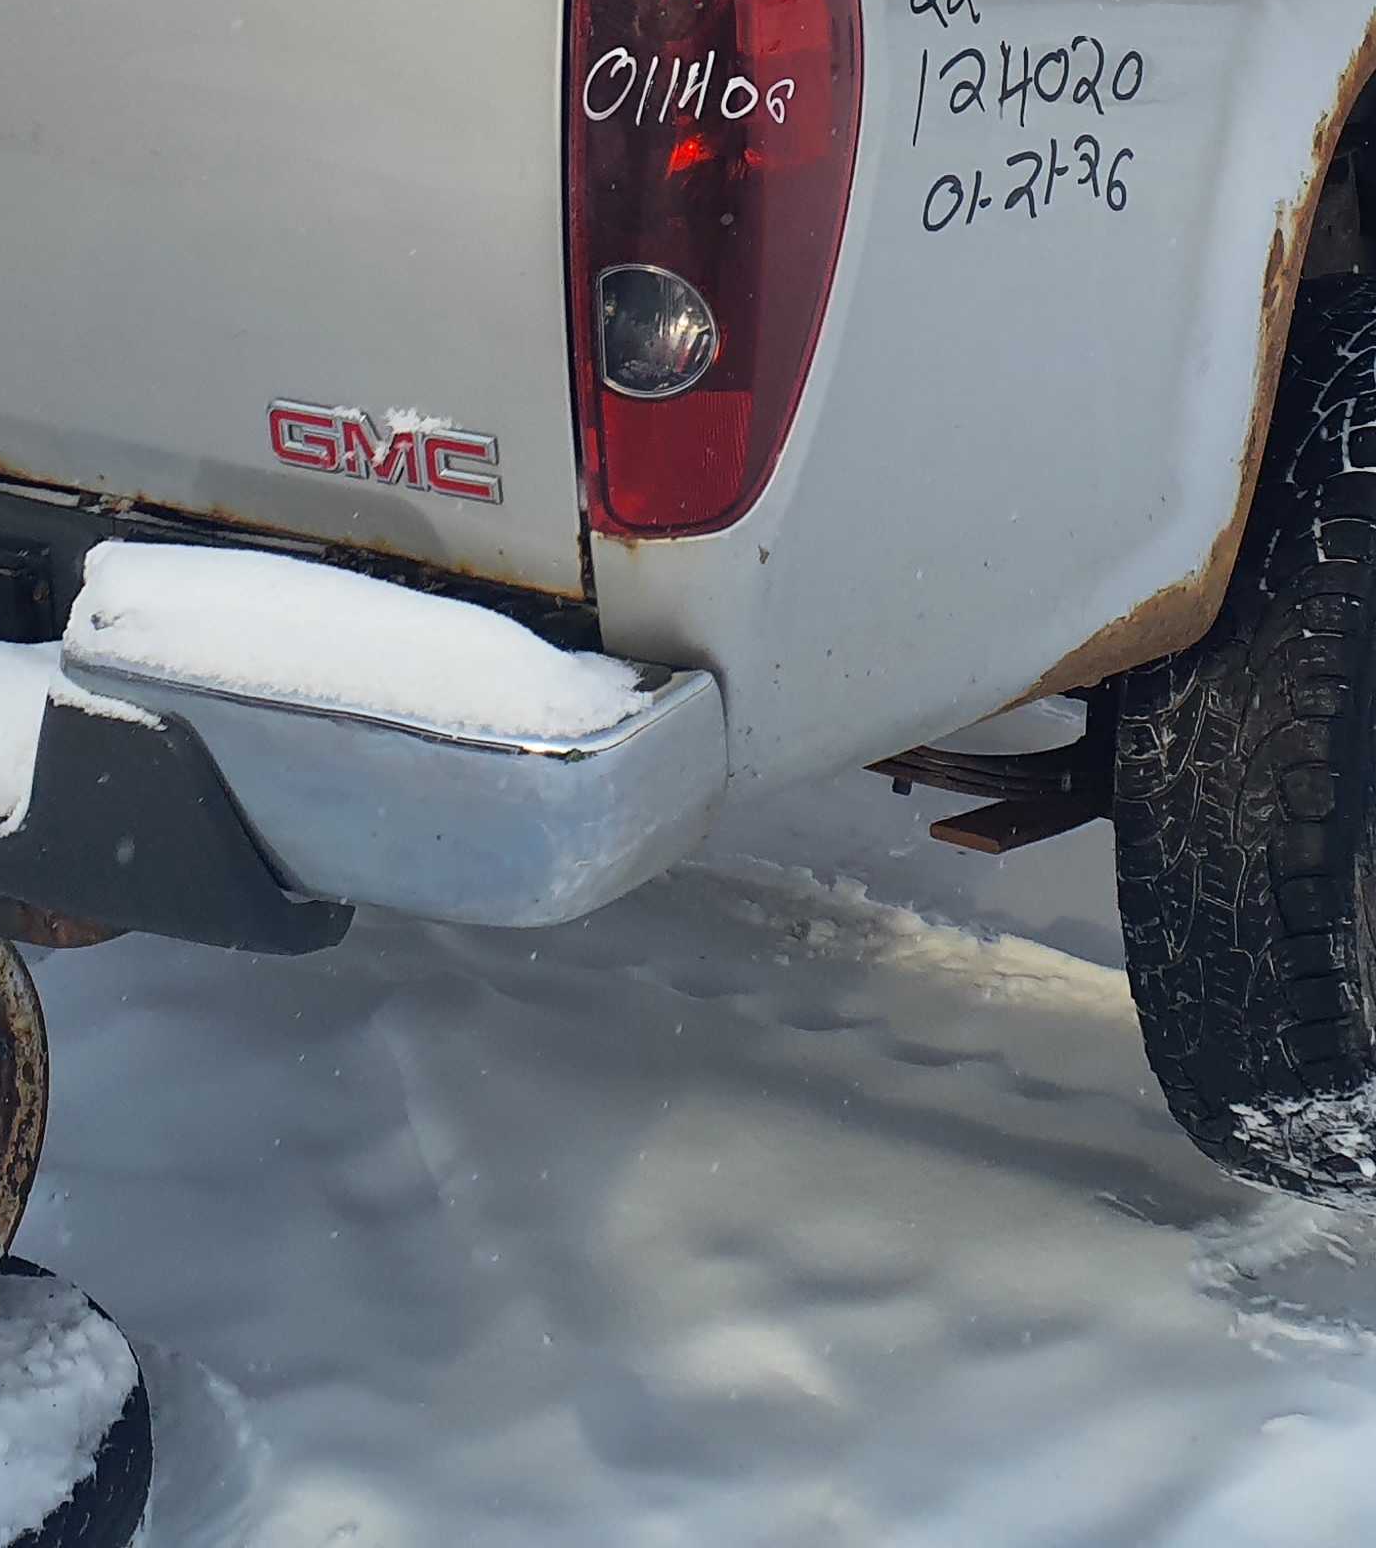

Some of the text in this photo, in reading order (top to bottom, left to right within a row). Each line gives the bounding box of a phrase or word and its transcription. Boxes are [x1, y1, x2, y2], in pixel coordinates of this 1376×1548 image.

[583, 47, 795, 126] 011406
[912, 35, 1144, 147] 124020
[267, 397, 504, 506] GMC
